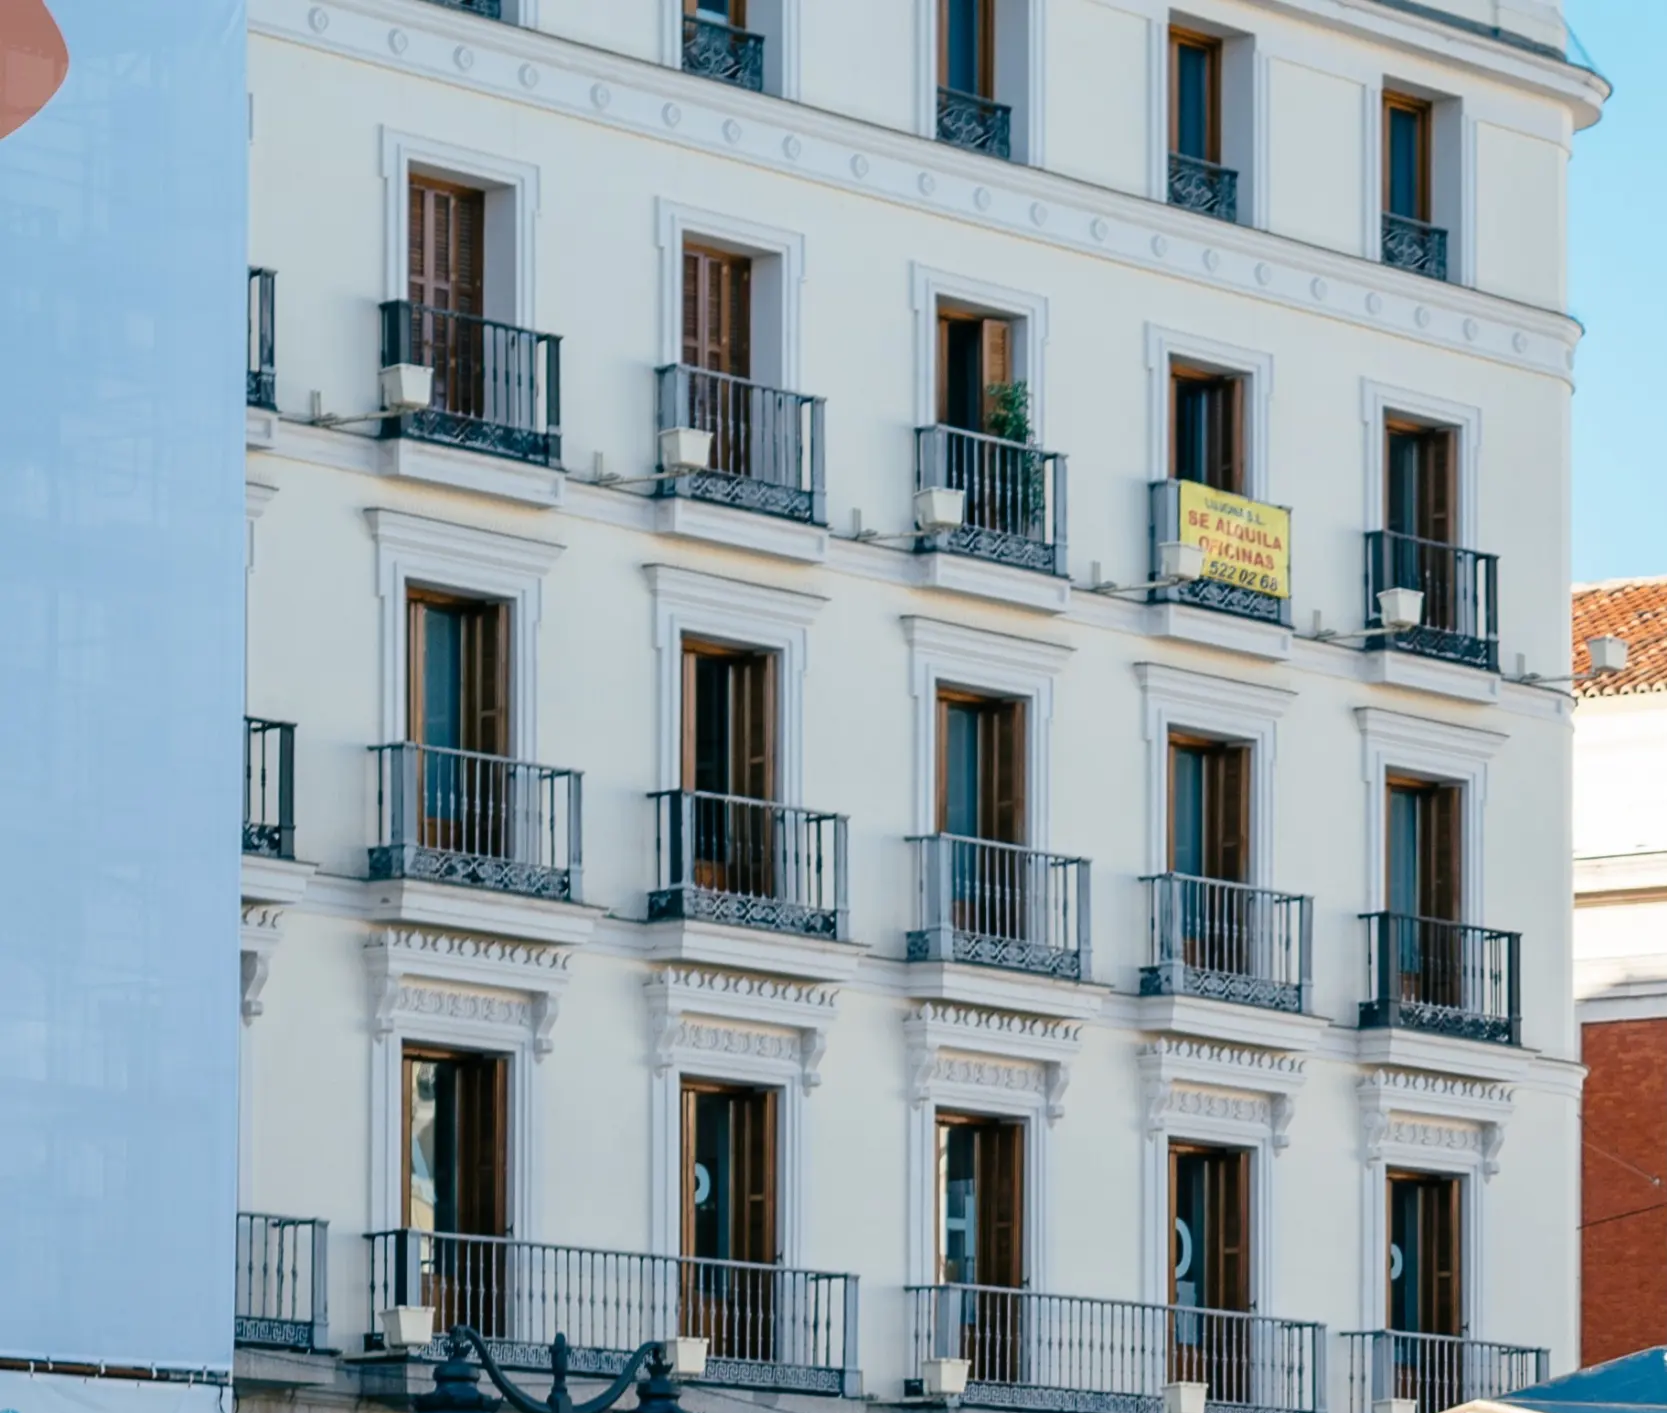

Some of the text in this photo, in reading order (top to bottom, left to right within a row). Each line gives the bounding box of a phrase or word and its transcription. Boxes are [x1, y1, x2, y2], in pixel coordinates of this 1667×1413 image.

[1188, 509, 1282, 551] SE ALQUILA
[1199, 535, 1275, 570] OFICINAS
[1209, 560, 1237, 580] 522
